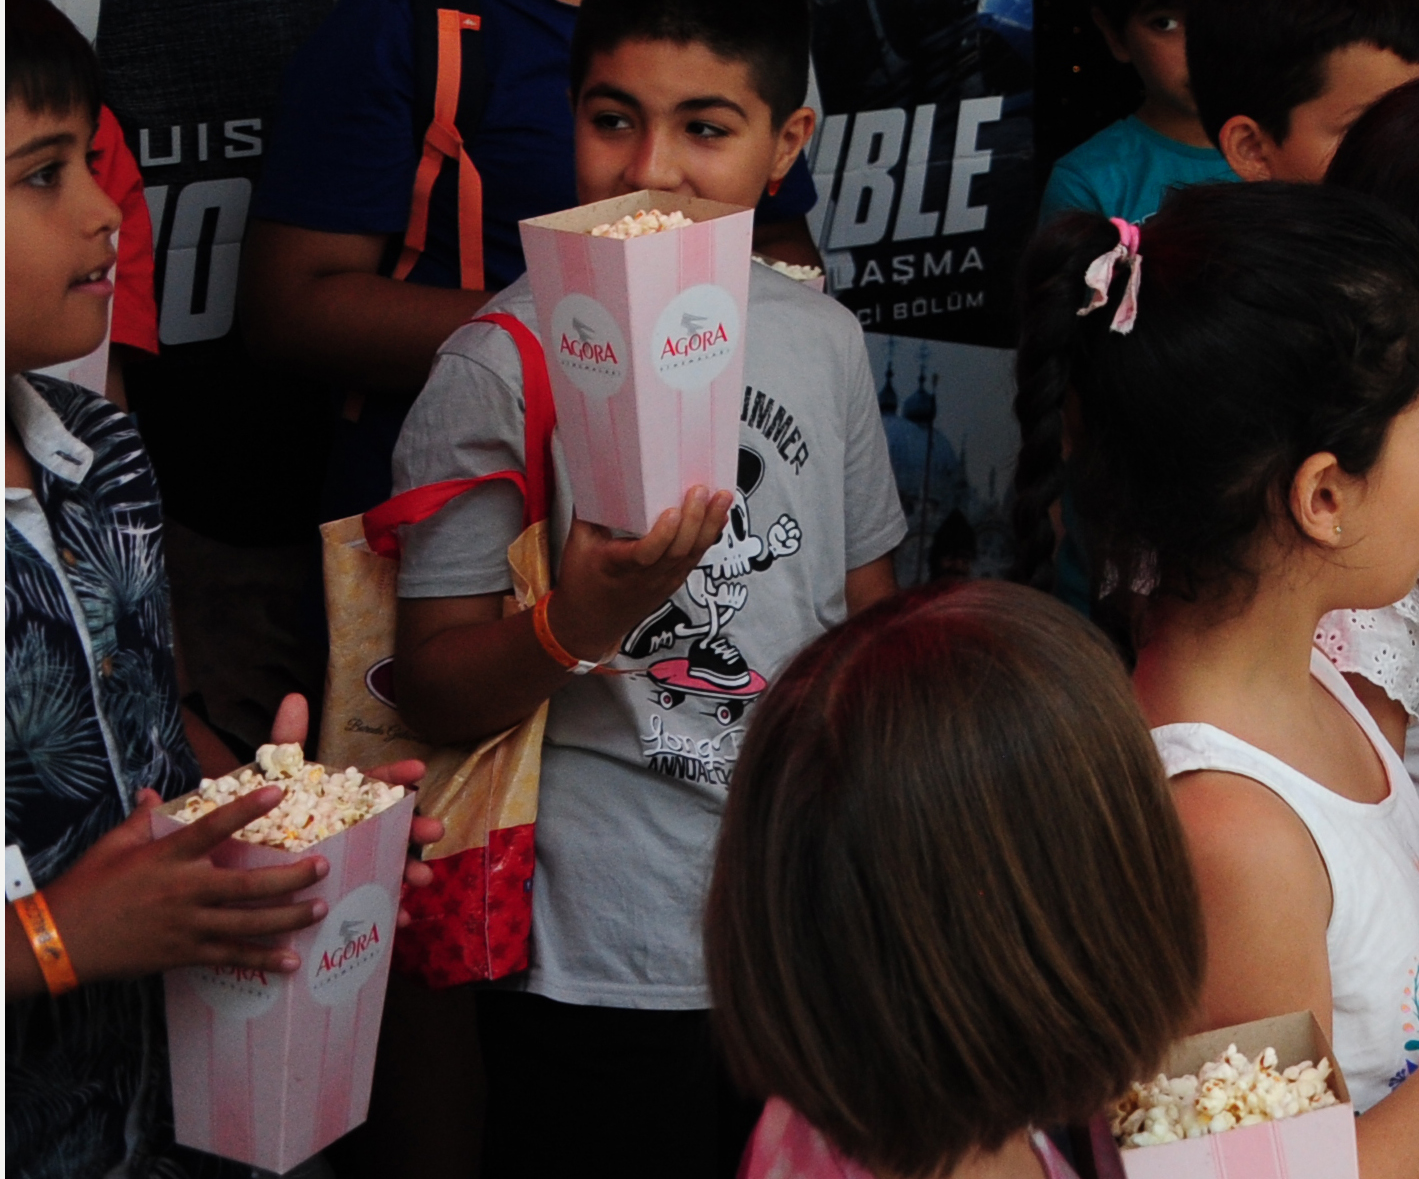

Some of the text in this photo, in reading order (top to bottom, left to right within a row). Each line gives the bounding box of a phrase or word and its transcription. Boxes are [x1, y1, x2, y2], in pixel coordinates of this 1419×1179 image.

[139, 118, 263, 168] UIS
[808, 95, 1004, 251] IBLE
[832, 246, 985, 291] LAŞMA
[856, 291, 986, 326] Cİ BÖLÜM
[560, 332, 618, 365] AGORA
[661, 322, 728, 360] AGORA
[740, 385, 810, 476] INNER
[315, 922, 380, 978] AGORA
